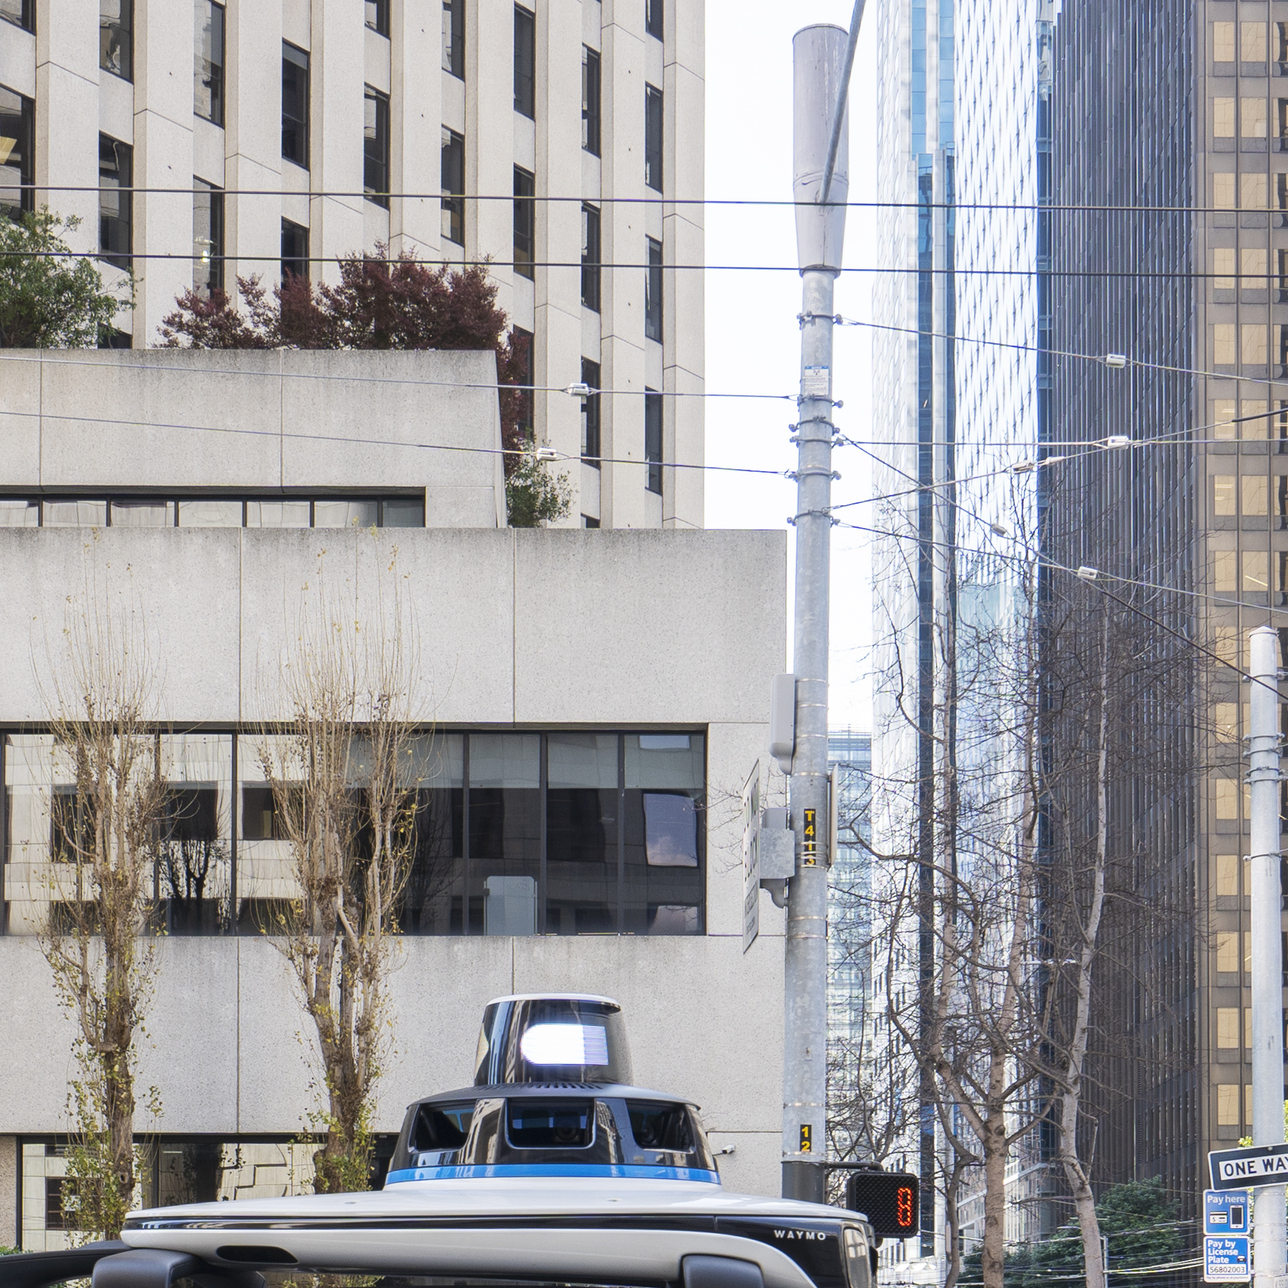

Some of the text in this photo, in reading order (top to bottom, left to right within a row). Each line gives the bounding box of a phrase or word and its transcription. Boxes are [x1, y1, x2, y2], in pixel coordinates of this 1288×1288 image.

[1224, 1160, 1257, 1176] ONE
[1207, 1195, 1245, 1205] Pay here
[897, 1187, 912, 1226] 8
[774, 1230, 826, 1240] WAYMO
[1208, 1240, 1236, 1248] Pay by
